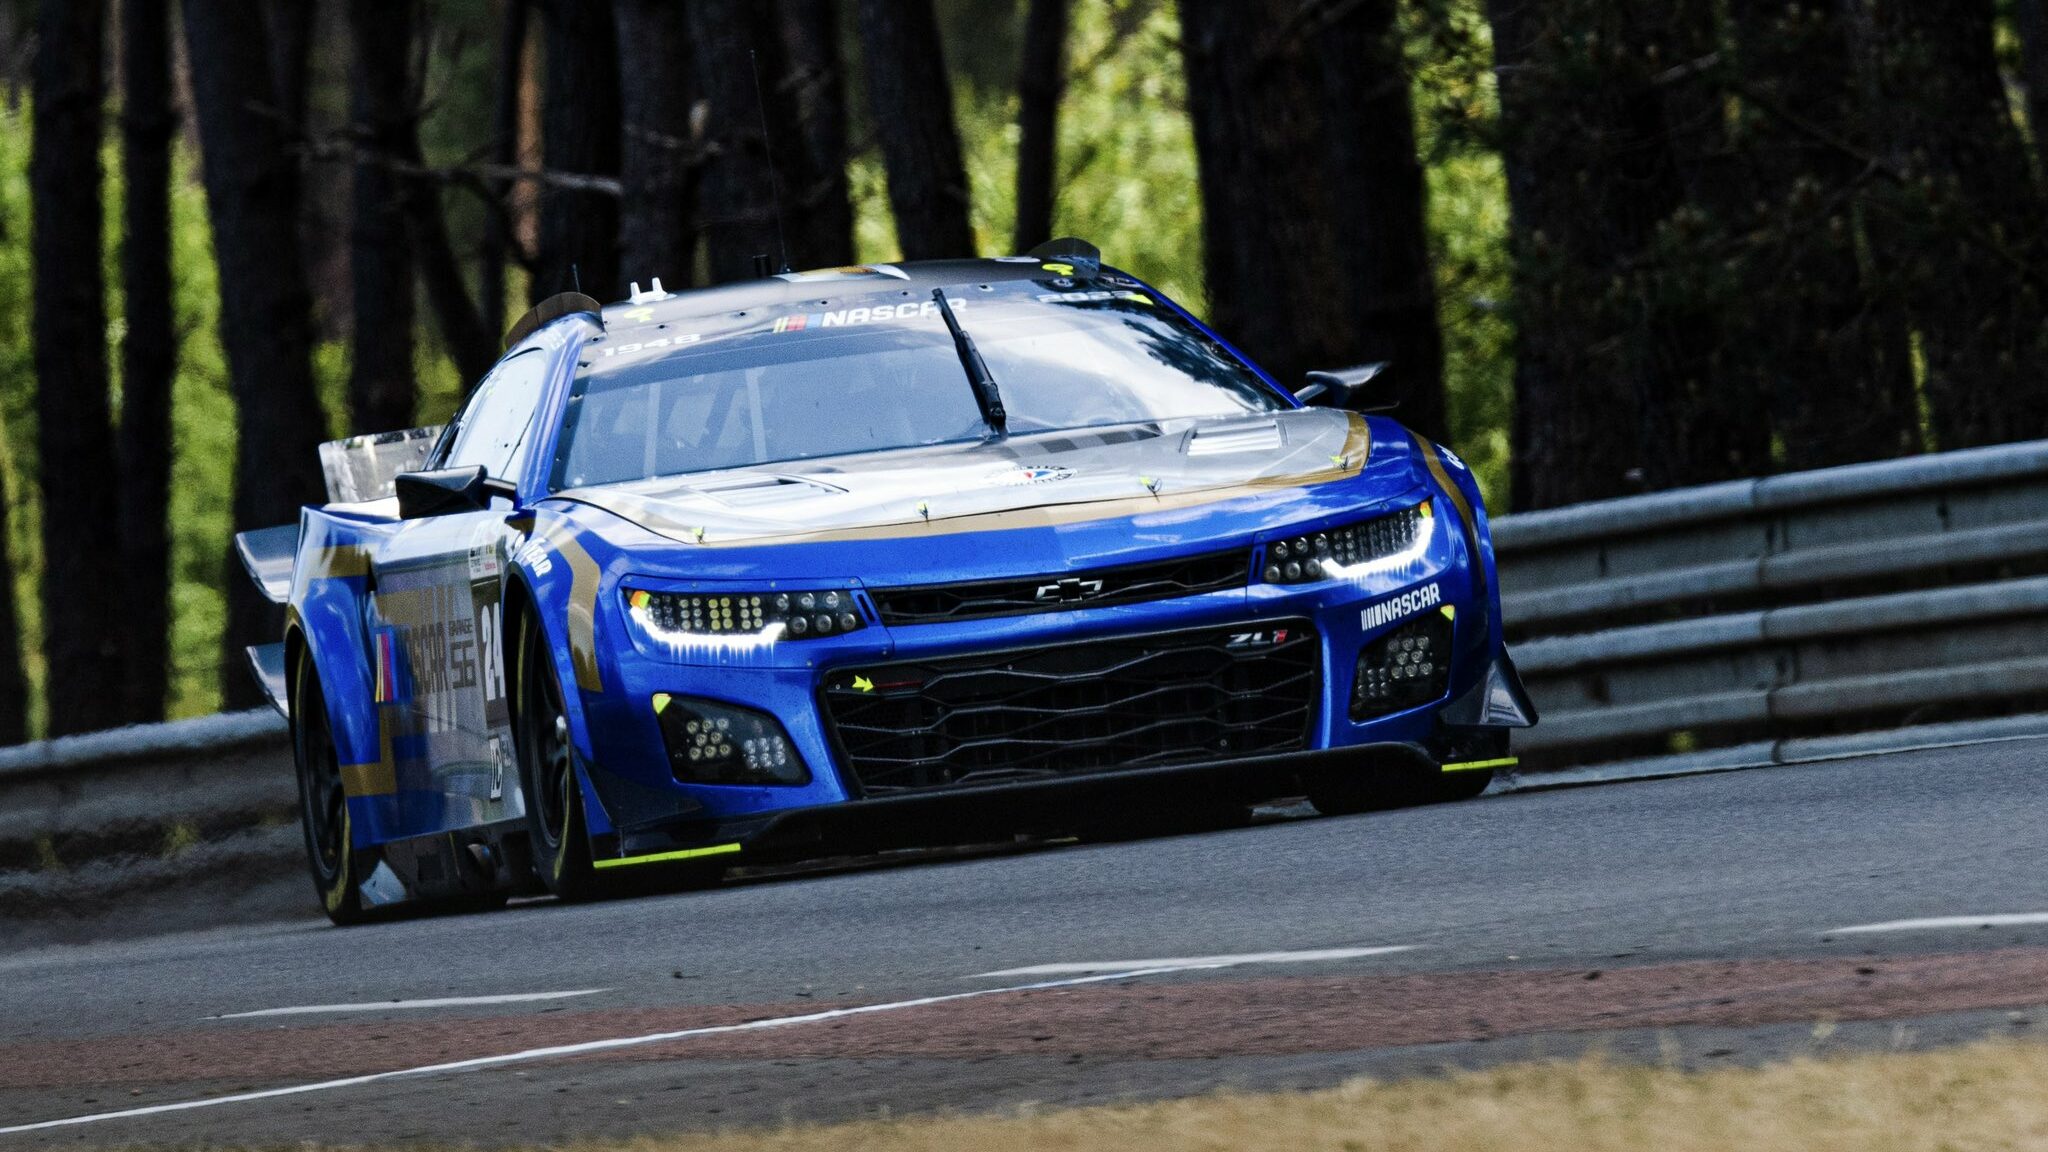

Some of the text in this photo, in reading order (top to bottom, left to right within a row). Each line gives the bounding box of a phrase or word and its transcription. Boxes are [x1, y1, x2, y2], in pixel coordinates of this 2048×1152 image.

[821, 297, 967, 328] NASCAR
[602, 333, 701, 357] 1948
[1381, 582, 1441, 624] NASCAR
[481, 602, 506, 701] 24
[1226, 629, 1289, 649] ZL1
[450, 640, 477, 690] 56
